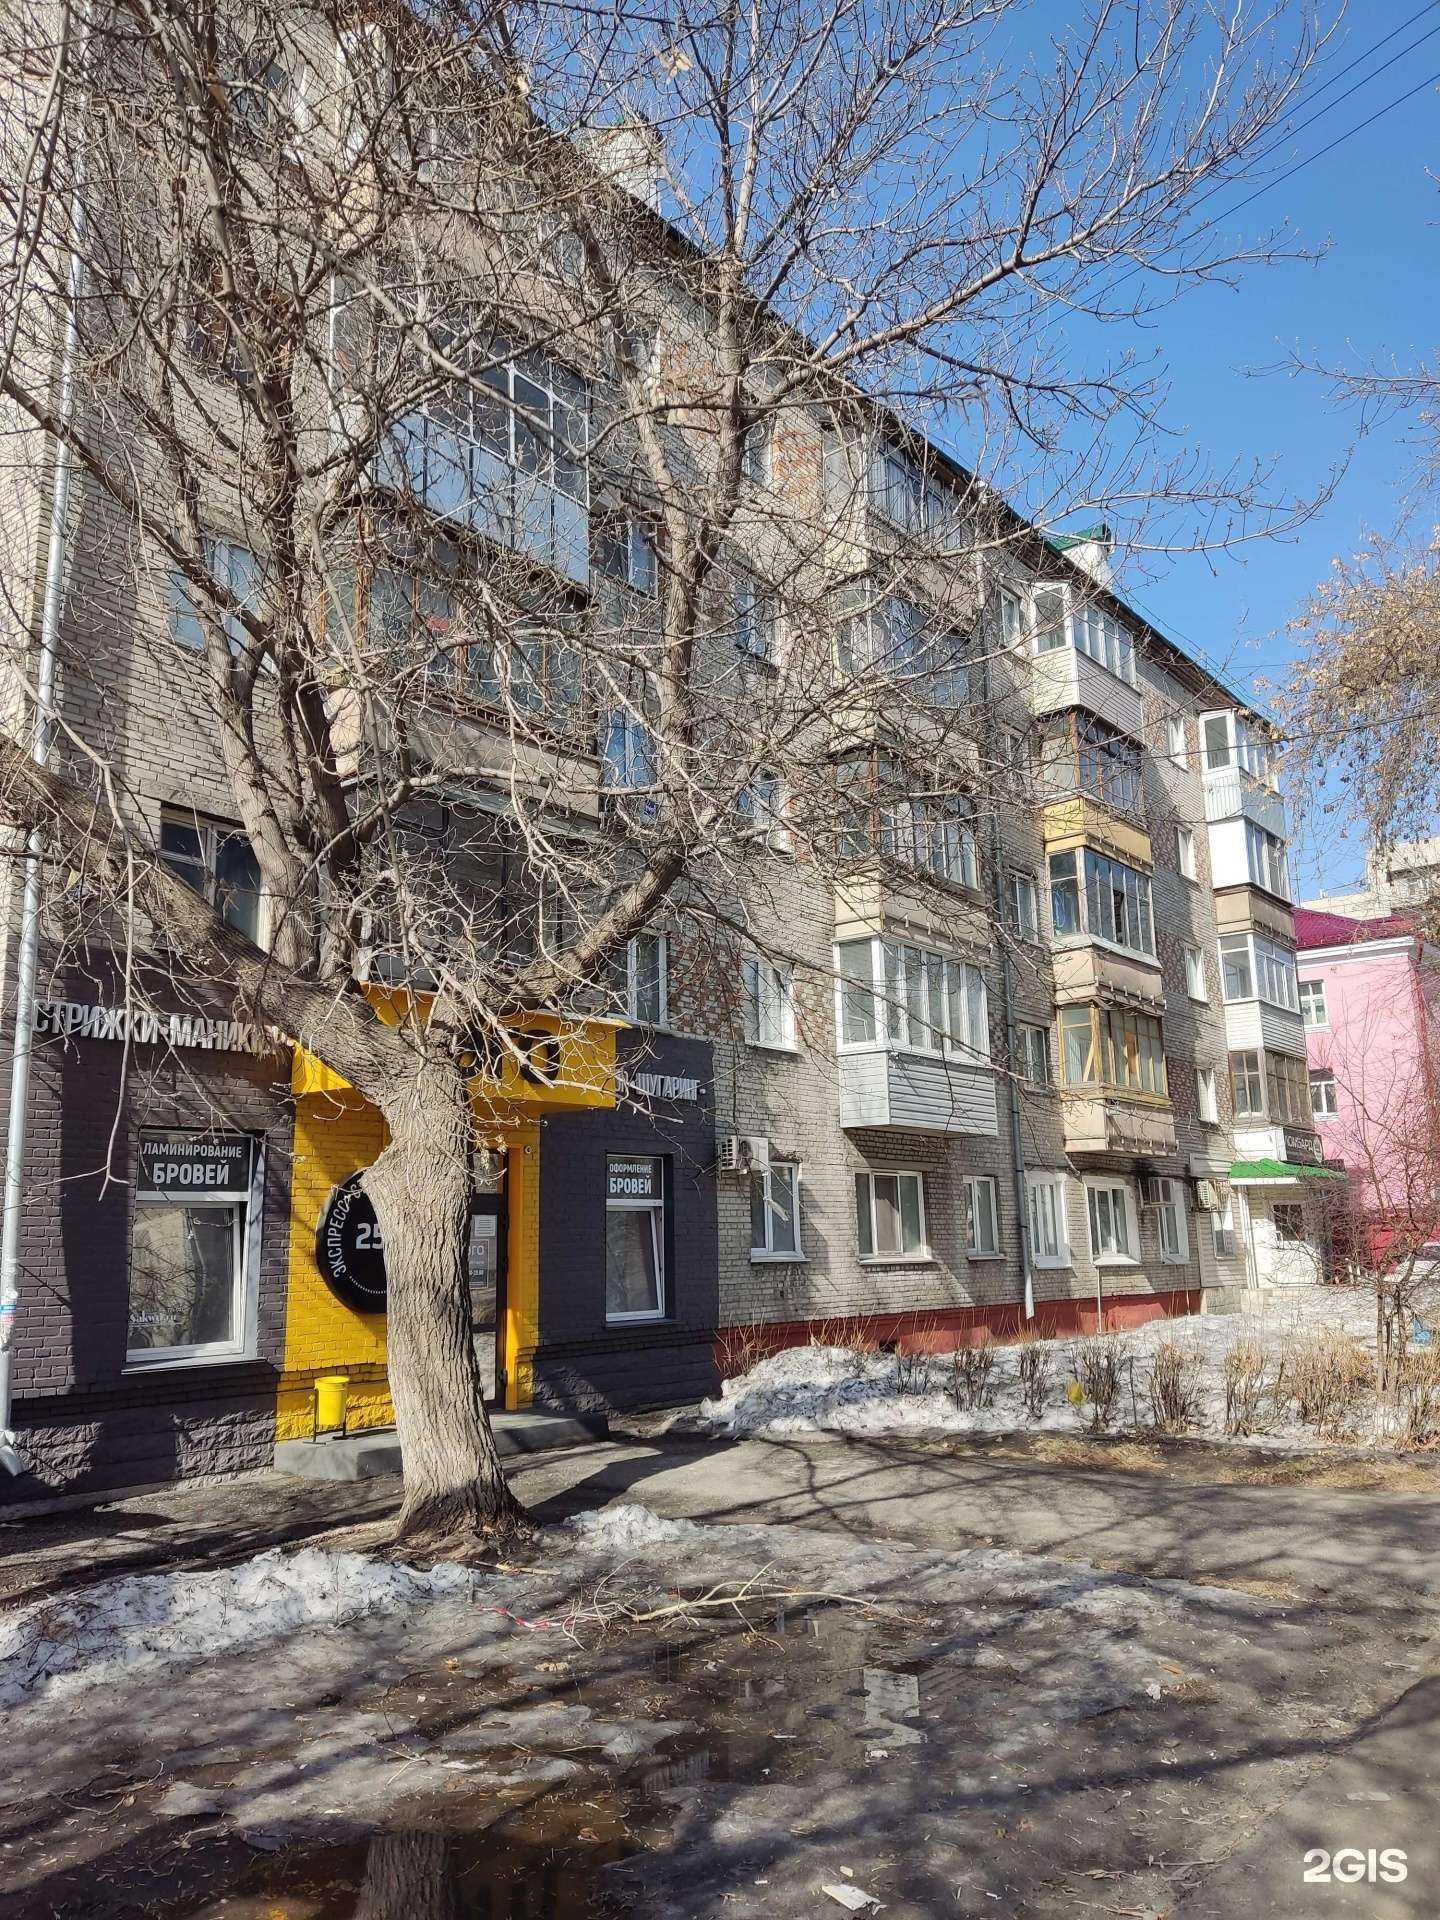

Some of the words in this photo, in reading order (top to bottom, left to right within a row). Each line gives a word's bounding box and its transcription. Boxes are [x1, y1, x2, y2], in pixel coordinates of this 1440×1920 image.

[33, 1000, 159, 1044] СТРИЖКИ
[635, 1072, 700, 1101] ШУГАРИНГ
[143, 1142, 242, 1158] ЛАМИНИРОВАНИЕ
[152, 1160, 229, 1185] БРОВЕЙ
[609, 1163, 652, 1174] ОФОРМЛЕНИЕ
[609, 1174, 652, 1194] БРОВЕЙ
